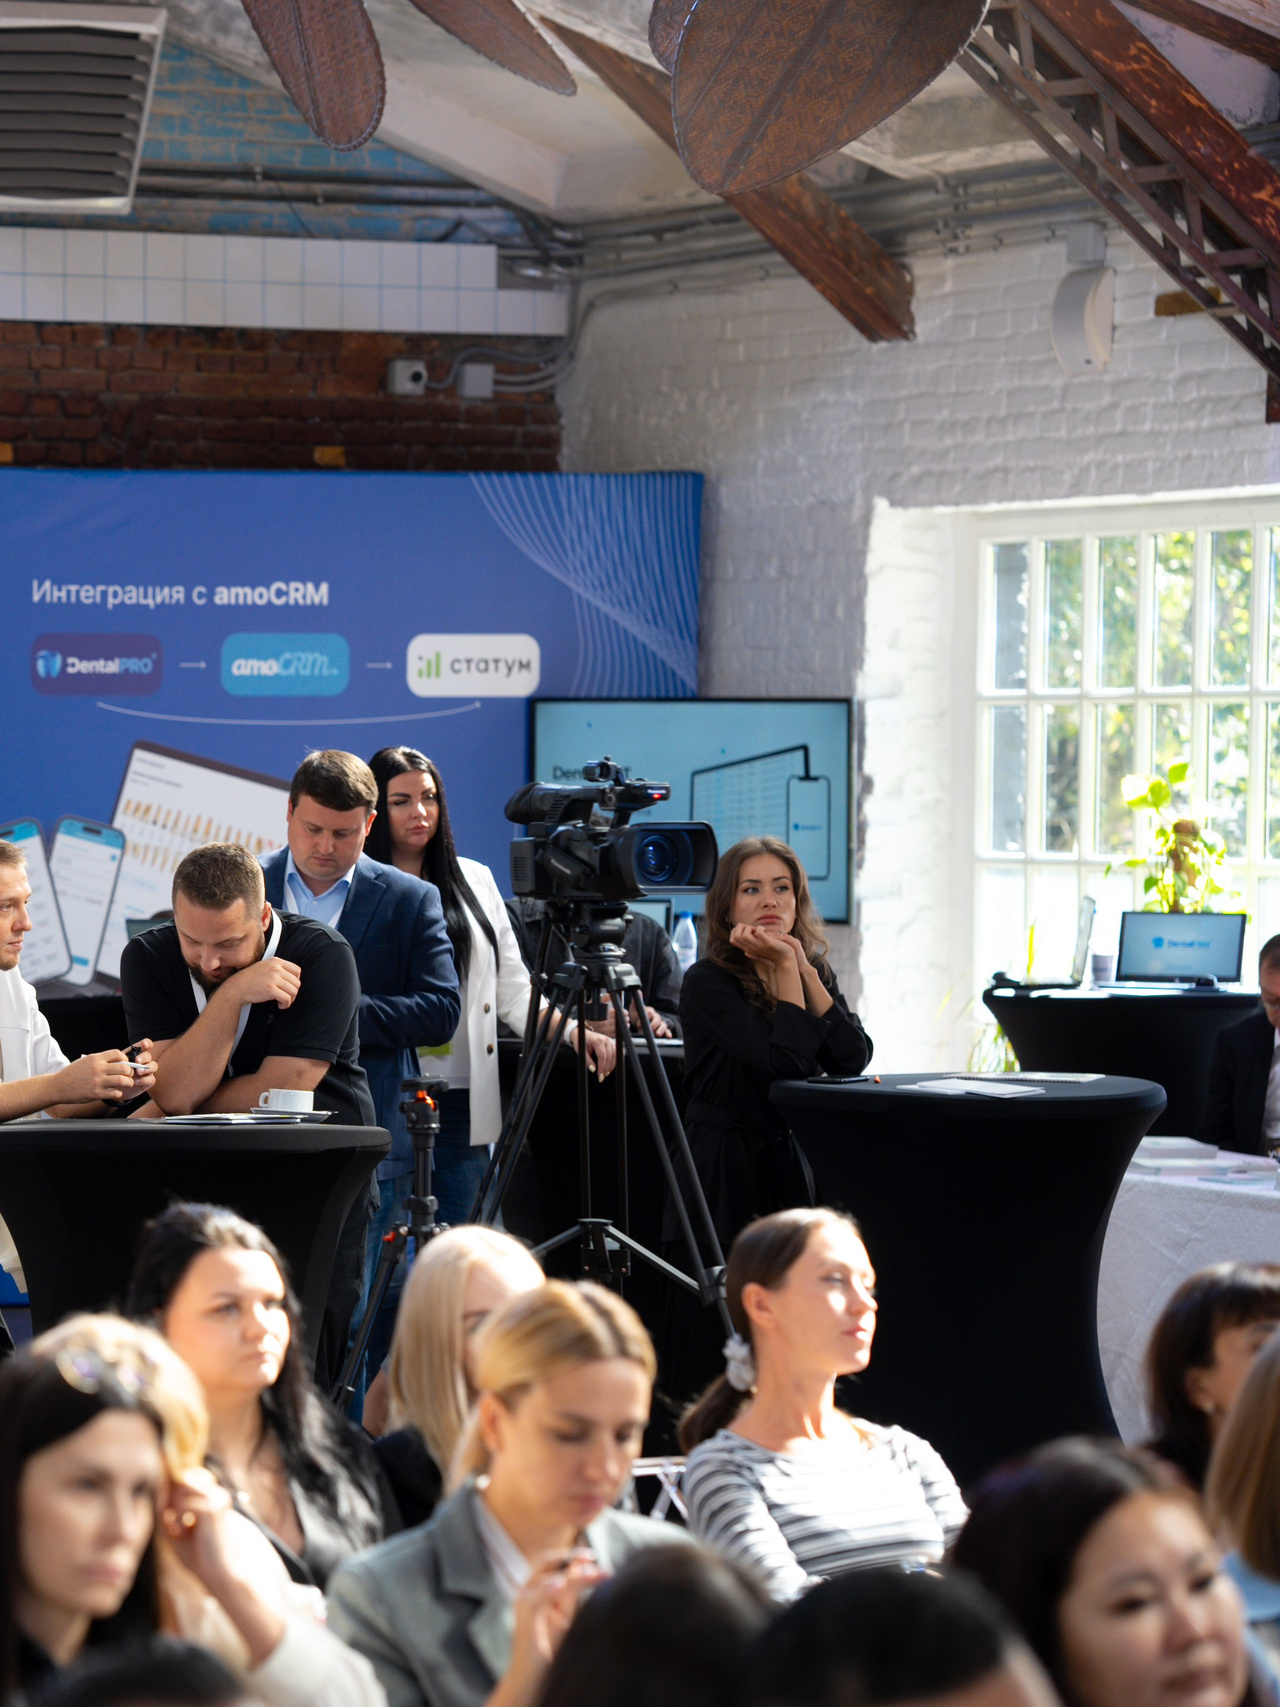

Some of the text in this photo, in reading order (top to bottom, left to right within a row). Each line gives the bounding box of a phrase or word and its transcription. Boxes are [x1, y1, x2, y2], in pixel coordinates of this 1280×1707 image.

[31, 578, 330, 610] Интеграция с amoCRM
